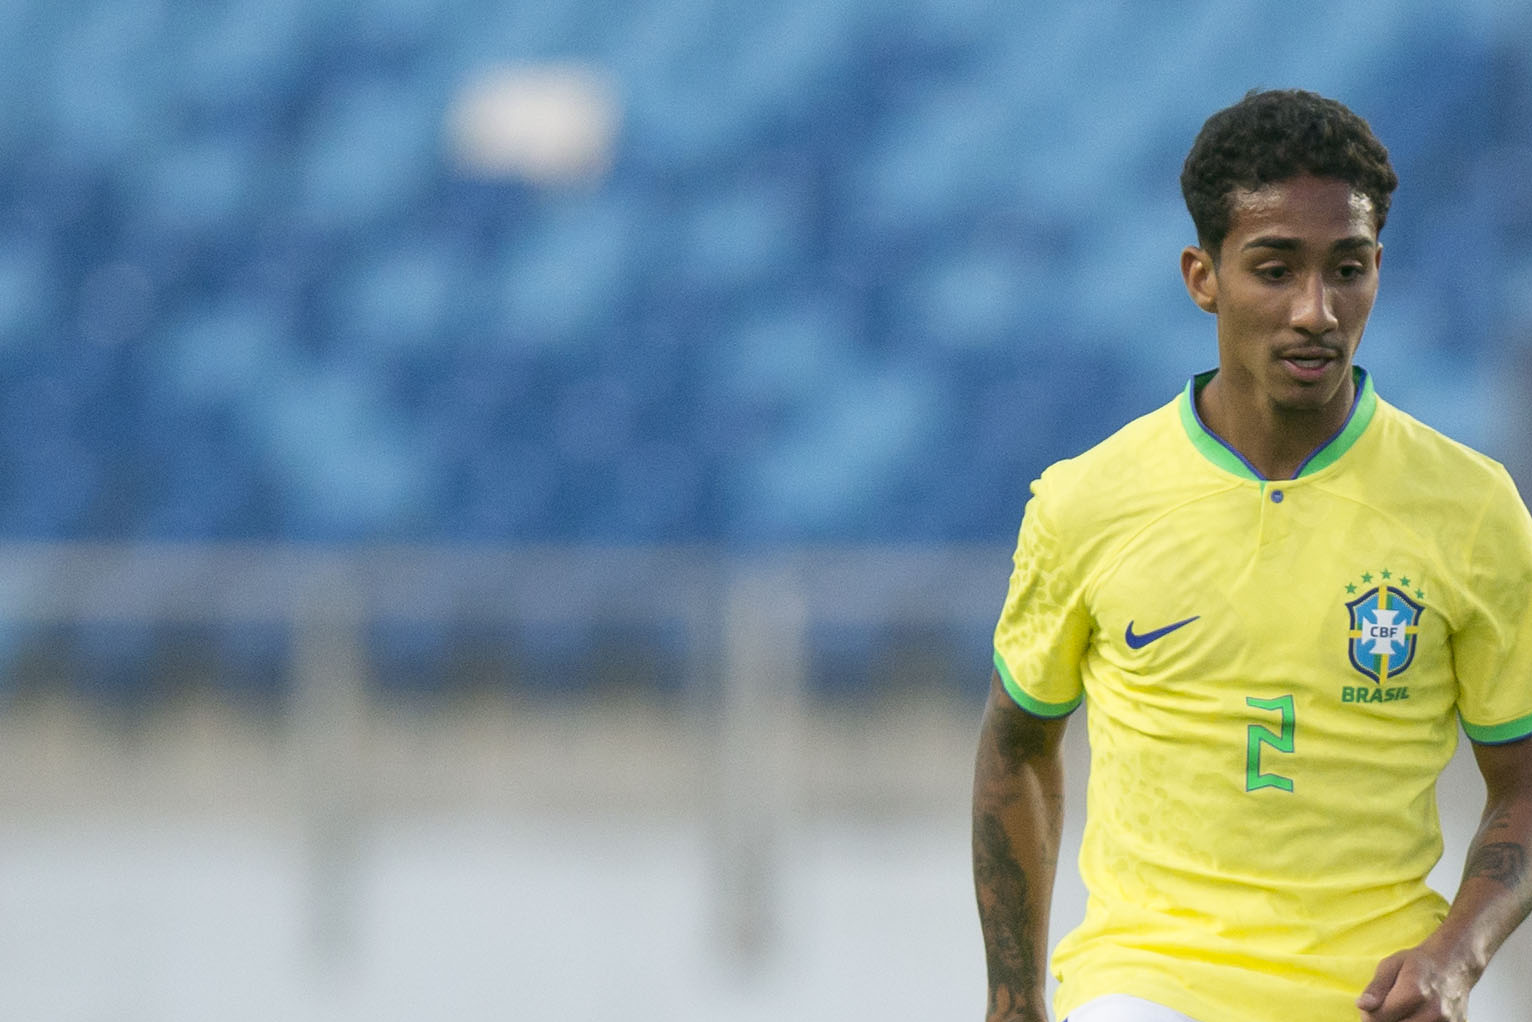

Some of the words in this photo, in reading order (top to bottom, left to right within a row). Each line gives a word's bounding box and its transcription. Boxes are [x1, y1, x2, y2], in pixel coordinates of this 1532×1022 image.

[1370, 626, 1398, 638] CBF
[1342, 686, 1409, 703] BRASIL
[1246, 694, 1295, 793] 2
